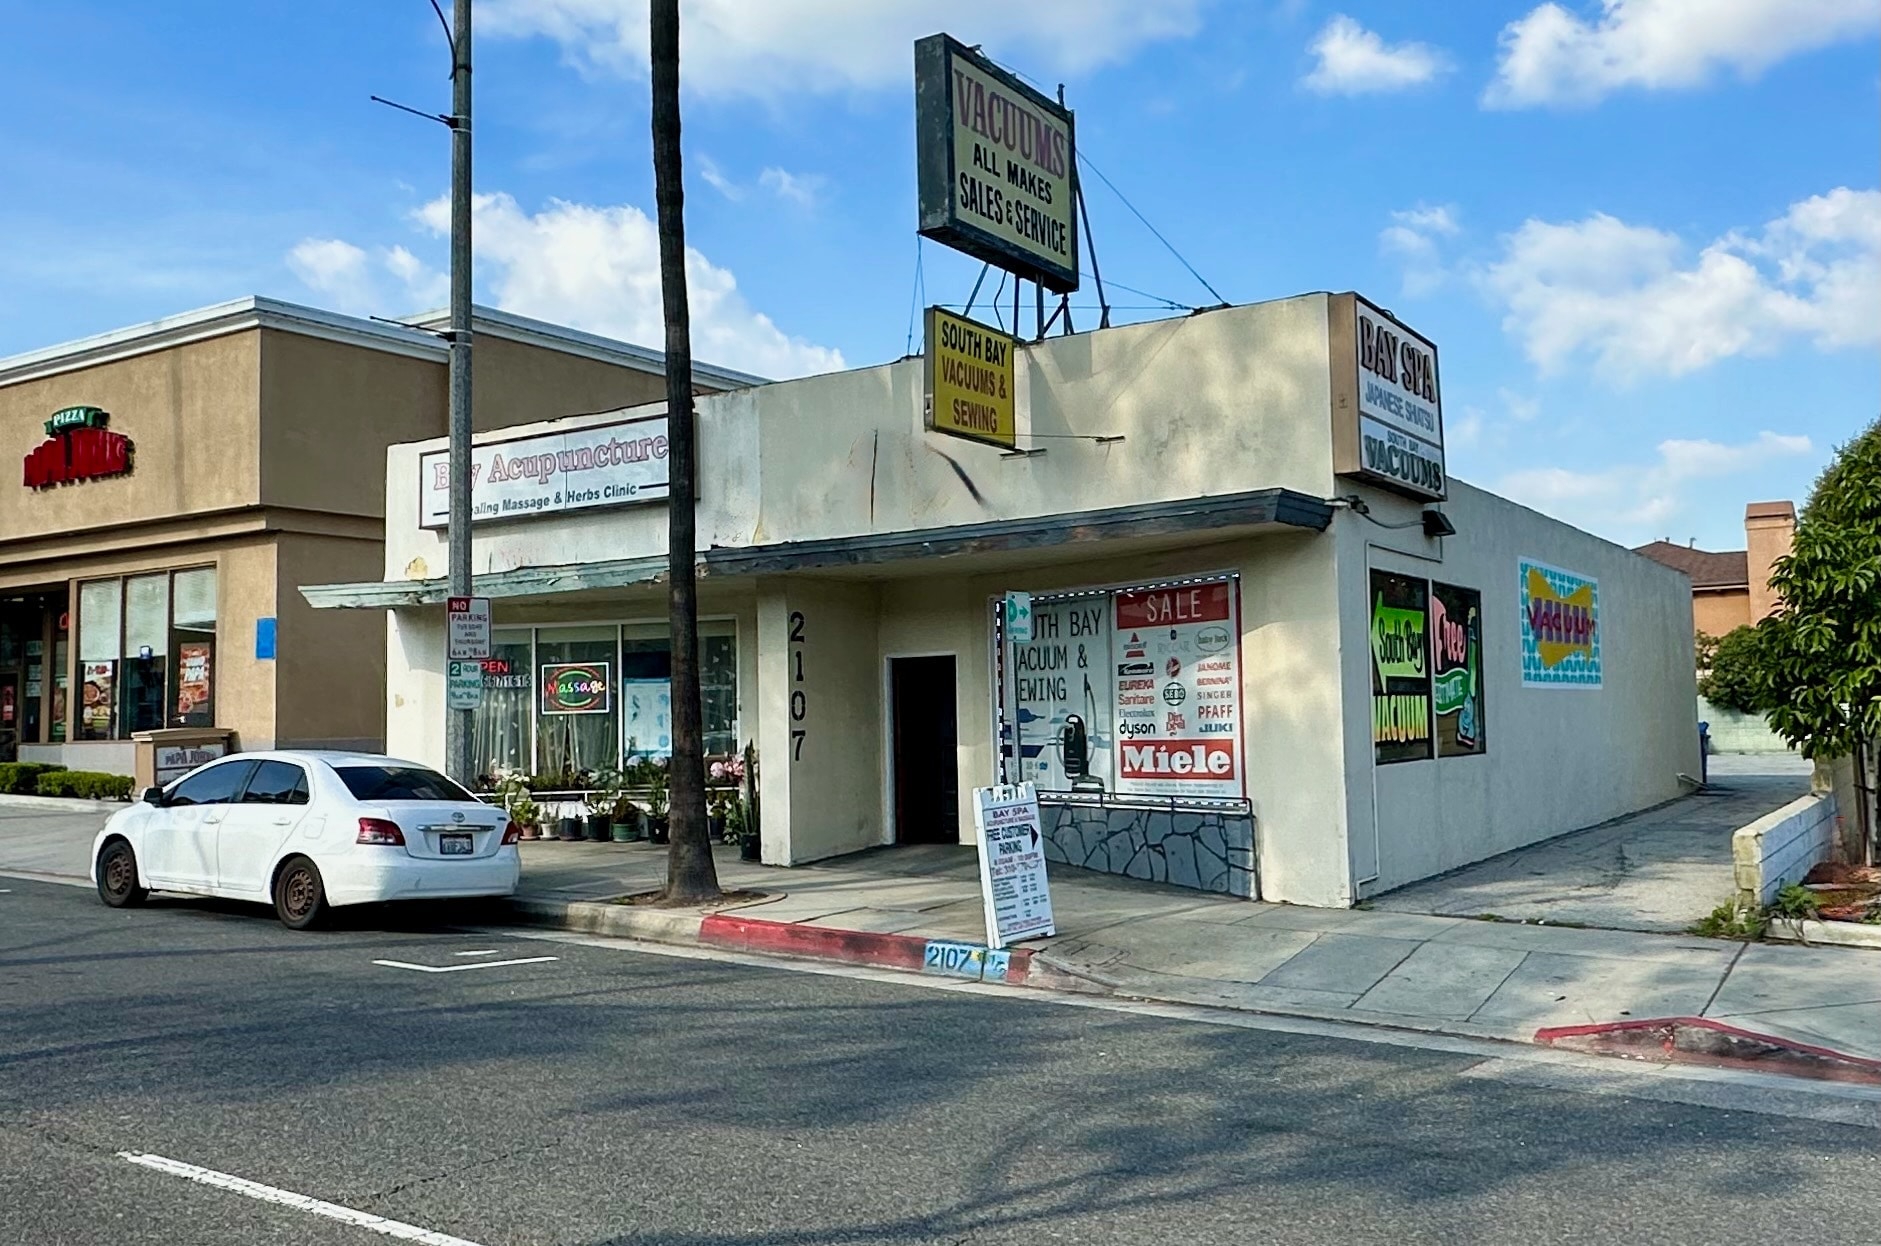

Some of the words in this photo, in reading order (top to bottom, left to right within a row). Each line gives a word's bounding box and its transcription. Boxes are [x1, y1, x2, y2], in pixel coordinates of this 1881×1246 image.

[953, 68, 1065, 180] VACUUMS
[973, 143, 1000, 178] ALL
[1007, 160, 1052, 205] MAKES
[959, 172, 1003, 225] SALES
[1005, 199, 1013, 223] &
[1015, 199, 1067, 256] SERVICE
[941, 320, 982, 360] SOUTH
[985, 336, 1006, 368] BAY
[1360, 315, 1399, 384] BAY
[1401, 341, 1436, 404] SPA
[941, 355, 996, 397] VACUUMS
[999, 374, 1007, 400] &
[53, 408, 85, 427] PIZZA
[953, 398, 998, 434] SEWING
[1365, 380, 1404, 419] JAPANESE
[1404, 400, 1434, 433] SHIATSU
[434, 462, 481, 491] By
[488, 435, 669, 484] Acupuncture
[1364, 434, 1442, 491] VACUUMS
[502, 496, 550, 512] Massage
[553, 492, 562, 504] &
[567, 487, 600, 502] Herbs
[603, 483, 637, 498] Clinic
[452, 601, 467, 611] NO
[1146, 589, 1202, 622] SALE
[1070, 608, 1101, 637] BAY
[1527, 604, 1595, 637] VACUUM
[1018, 645, 1067, 672] ACUUM
[1077, 643, 1087, 668] &
[1379, 617, 1405, 664] South
[1404, 619, 1425, 673] Bay
[451, 664, 460, 675] 2
[480, 661, 508, 673] PEN
[545, 680, 606, 698] Massage
[789, 611, 806, 762] 2107
[1019, 677, 1067, 702] EWING
[1118, 679, 1154, 691] EUREKA
[1118, 694, 1155, 705] Sanitaire
[1164, 689, 1185, 699] SEBO
[1197, 690, 1232, 700] SINGER
[1198, 705, 1233, 719] PFAFF
[1374, 694, 1429, 742] VACUUM
[1119, 719, 1156, 739] dyson
[1199, 723, 1233, 733] JUKI
[1122, 745, 1231, 774] Miele
[992, 809, 1009, 818] BAY
[1012, 807, 1029, 816] SPA
[926, 945, 972, 972] 2107
